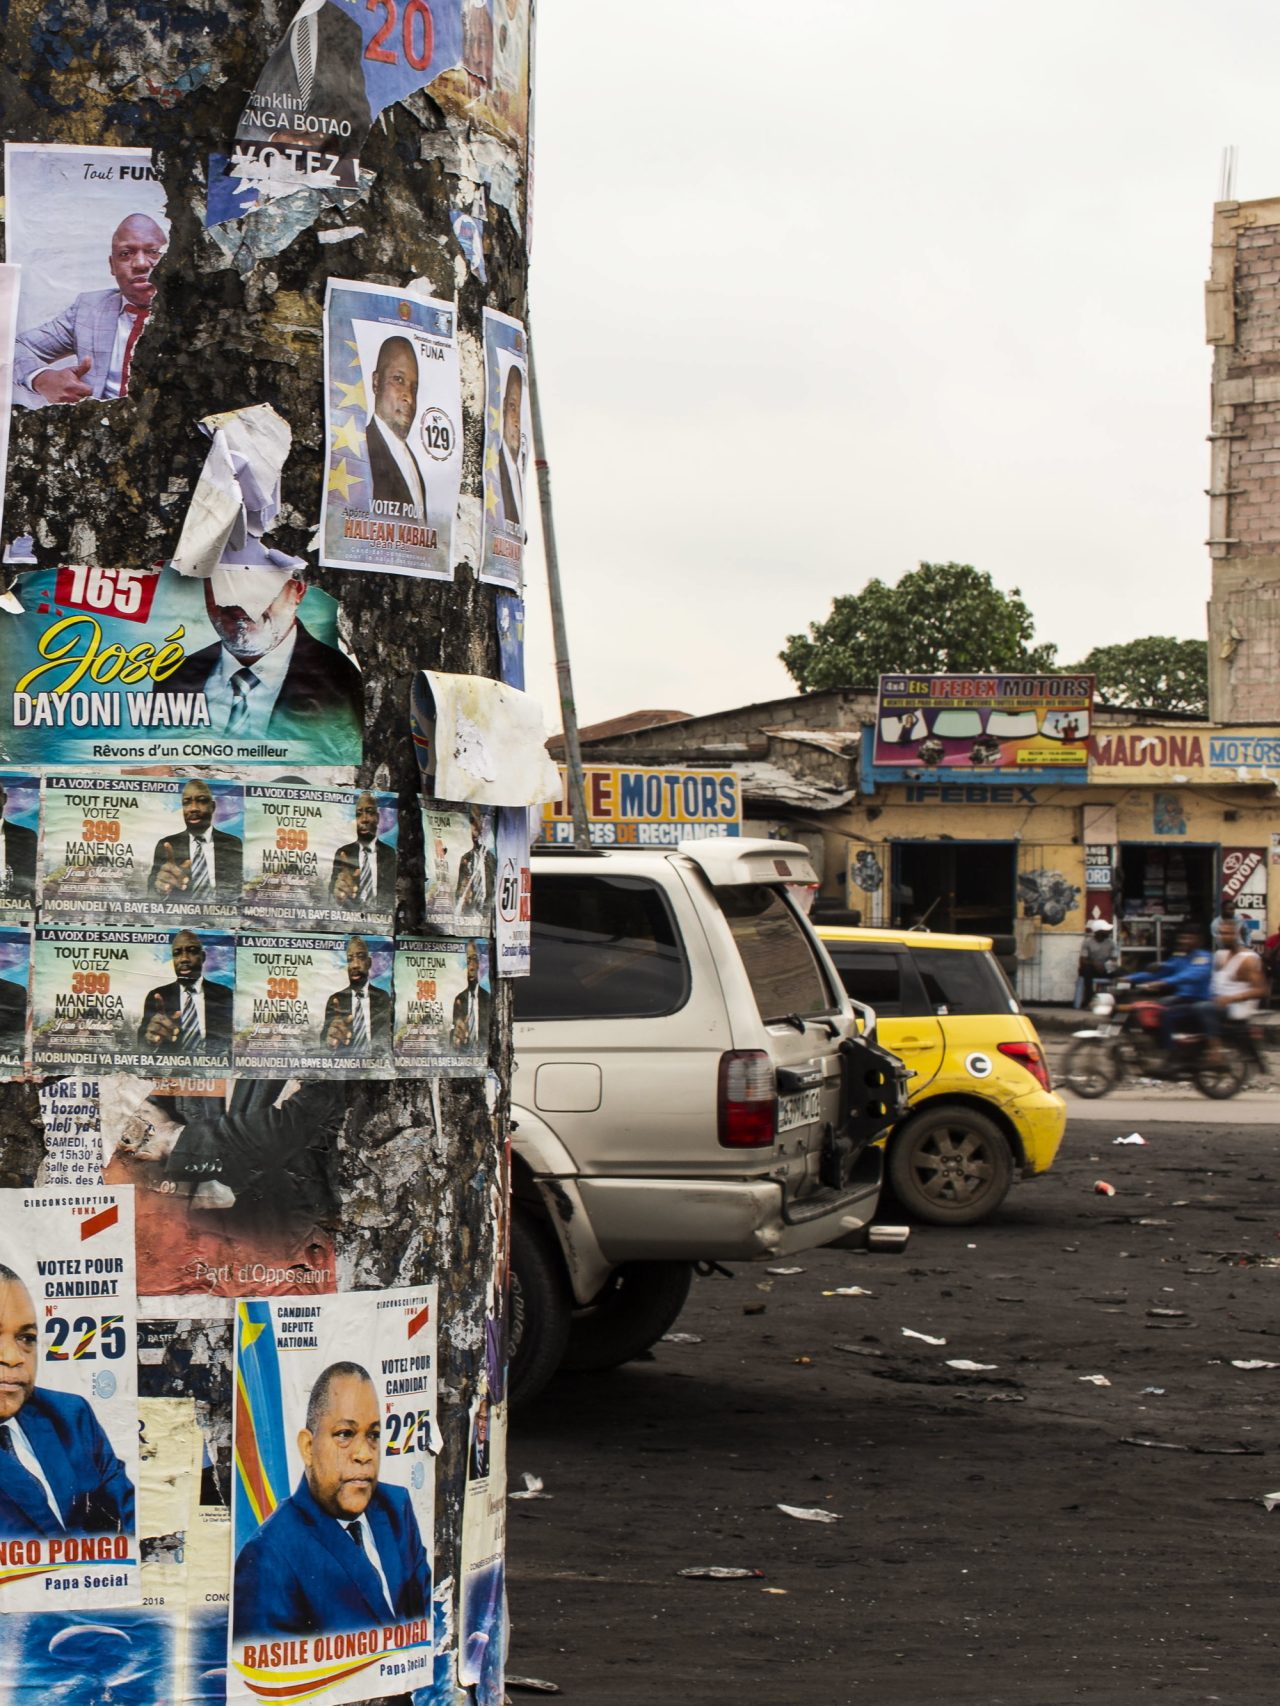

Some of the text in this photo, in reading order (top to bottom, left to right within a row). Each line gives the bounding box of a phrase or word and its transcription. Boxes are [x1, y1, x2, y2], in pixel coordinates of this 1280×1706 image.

[294, 114, 351, 136] BOTAO
[83, 164, 113, 180] Tout
[421, 344, 445, 361] FUNA
[425, 425, 450, 451] 129
[369, 499, 400, 516] VOTEZ
[68, 567, 143, 615] 165
[14, 615, 186, 704] José
[930, 679, 998, 697] IFEBEX
[1003, 680, 1089, 697] MOTORS
[13, 692, 210, 727] DAYONI WAWA
[93, 744, 288, 758] Rêvons d'un CONGO meilleur
[1088, 735, 1204, 768] MADONA
[1210, 742, 1280, 763] MOTORS
[620, 773, 736, 818] MOTORS
[905, 786, 1037, 804] IFEBEX
[617, 823, 728, 845] DE RECHANGE
[1222, 852, 1262, 897] TOYOTA
[1238, 895, 1266, 908] OPEL
[82, 1082, 99, 1098] DE
[46, 1138, 87, 1148] SAMEDI,
[45, 1162, 84, 1172] Salle de
[76, 1175, 93, 1185] des
[24, 1196, 116, 1208] CIRCONSCRIPTION
[72, 1207, 97, 1216] FUNA
[38, 1257, 123, 1276] VOTEZ POUR
[45, 1279, 118, 1298] CANDIDAT
[45, 1304, 58, 1317] N°
[277, 1306, 321, 1319] CANDIDAT
[282, 1322, 314, 1334] DEPUTE
[45, 1315, 126, 1361] 225
[277, 1336, 318, 1349] NATIONAL
[381, 1355, 431, 1375] VOTEZ POUR
[386, 1376, 428, 1395] CANDIDAT
[385, 1409, 431, 1457] 225
[49, 1534, 129, 1564] PONGO
[45, 1573, 129, 1591] Papa Social
[142, 1596, 165, 1607] 2018
[244, 1617, 428, 1668] BASILE OLONGO PONGO
[380, 1656, 428, 1677] Papa Social
